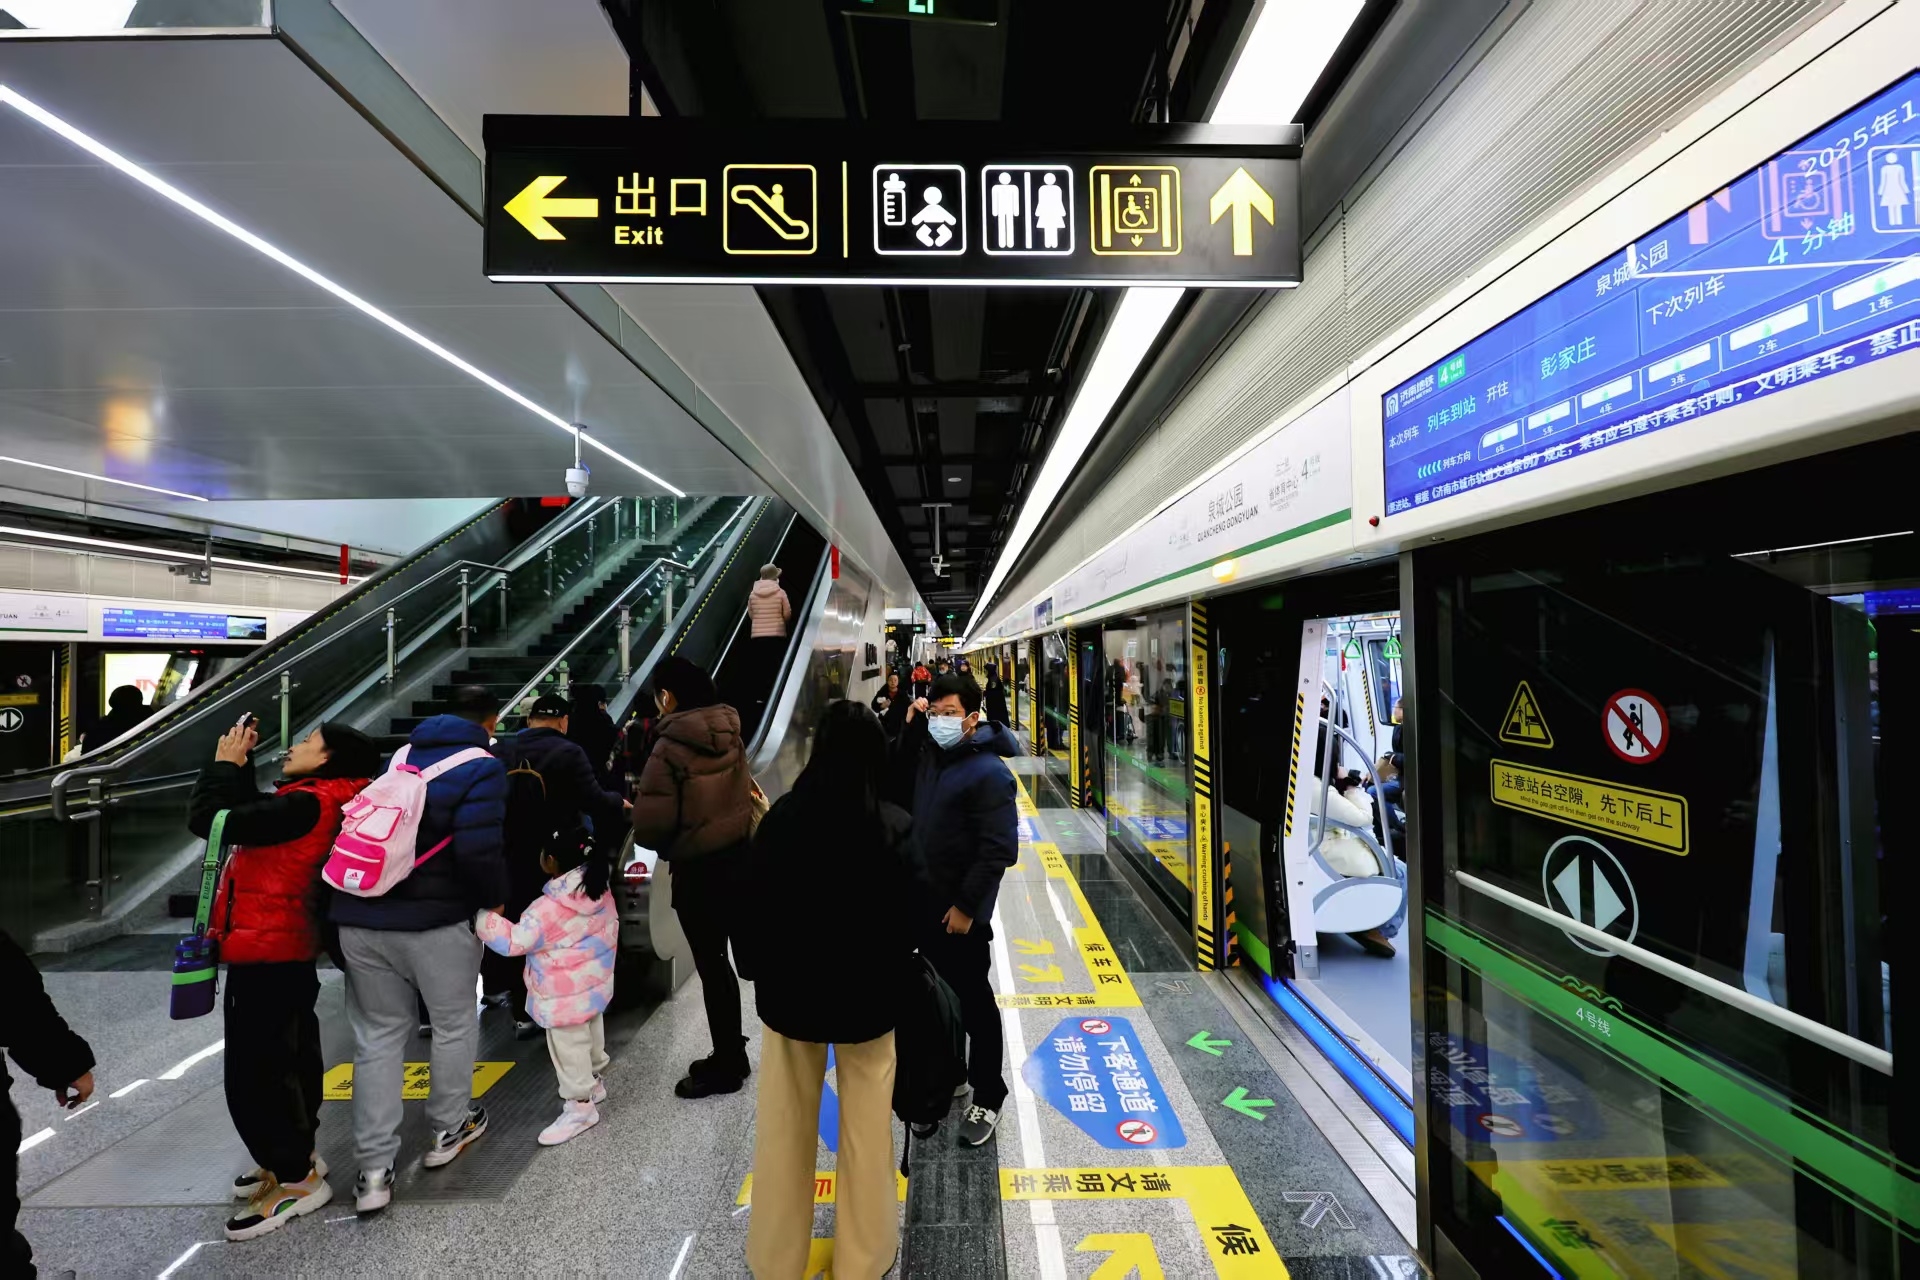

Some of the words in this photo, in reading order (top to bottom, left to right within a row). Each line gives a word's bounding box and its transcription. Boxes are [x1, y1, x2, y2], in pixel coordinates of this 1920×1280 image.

[614, 172, 708, 217] 出口
[614, 226, 664, 246] Exit
[1767, 237, 1789, 264] 4
[1801, 211, 1854, 256] 分钟
[1596, 241, 1669, 297] 泉城公园
[1645, 274, 1726, 326] 下次列车
[1868, 294, 1894, 314] 1车
[1540, 335, 1597, 380] 彭家庄
[1757, 338, 1778, 355] 2车
[1400, 374, 1434, 402] 济南地铁
[1440, 366, 1449, 383] 4
[1670, 372, 1687, 388] 3车
[1486, 380, 1509, 403] 开往
[1427, 395, 1477, 433] 列车到站
[1600, 403, 1613, 415] 4车
[1388, 425, 1420, 449] 本次列车
[1542, 425, 1554, 436] 5车
[1301, 458, 1309, 480] 4
[1442, 450, 1471, 470] 列车方向
[1208, 482, 1243, 523] 泉城公园
[1197, 520, 1226, 542] QUANCHENG
[1226, 504, 1259, 529] GONGYUAN
[1501, 771, 1674, 829] 注意站台空隙，先下后上
[1616, 820, 1641, 832] subway
[1201, 868, 1209, 895] crushing
[1083, 943, 1122, 984] 候车区
[1575, 1006, 1612, 1038] 4号线
[1052, 1035, 1109, 1113] 请勿停留
[1097, 1035, 1159, 1114] 下客通道
[1009, 1172, 1172, 1193] 请文明乘车
[1210, 1223, 1260, 1256] 候
